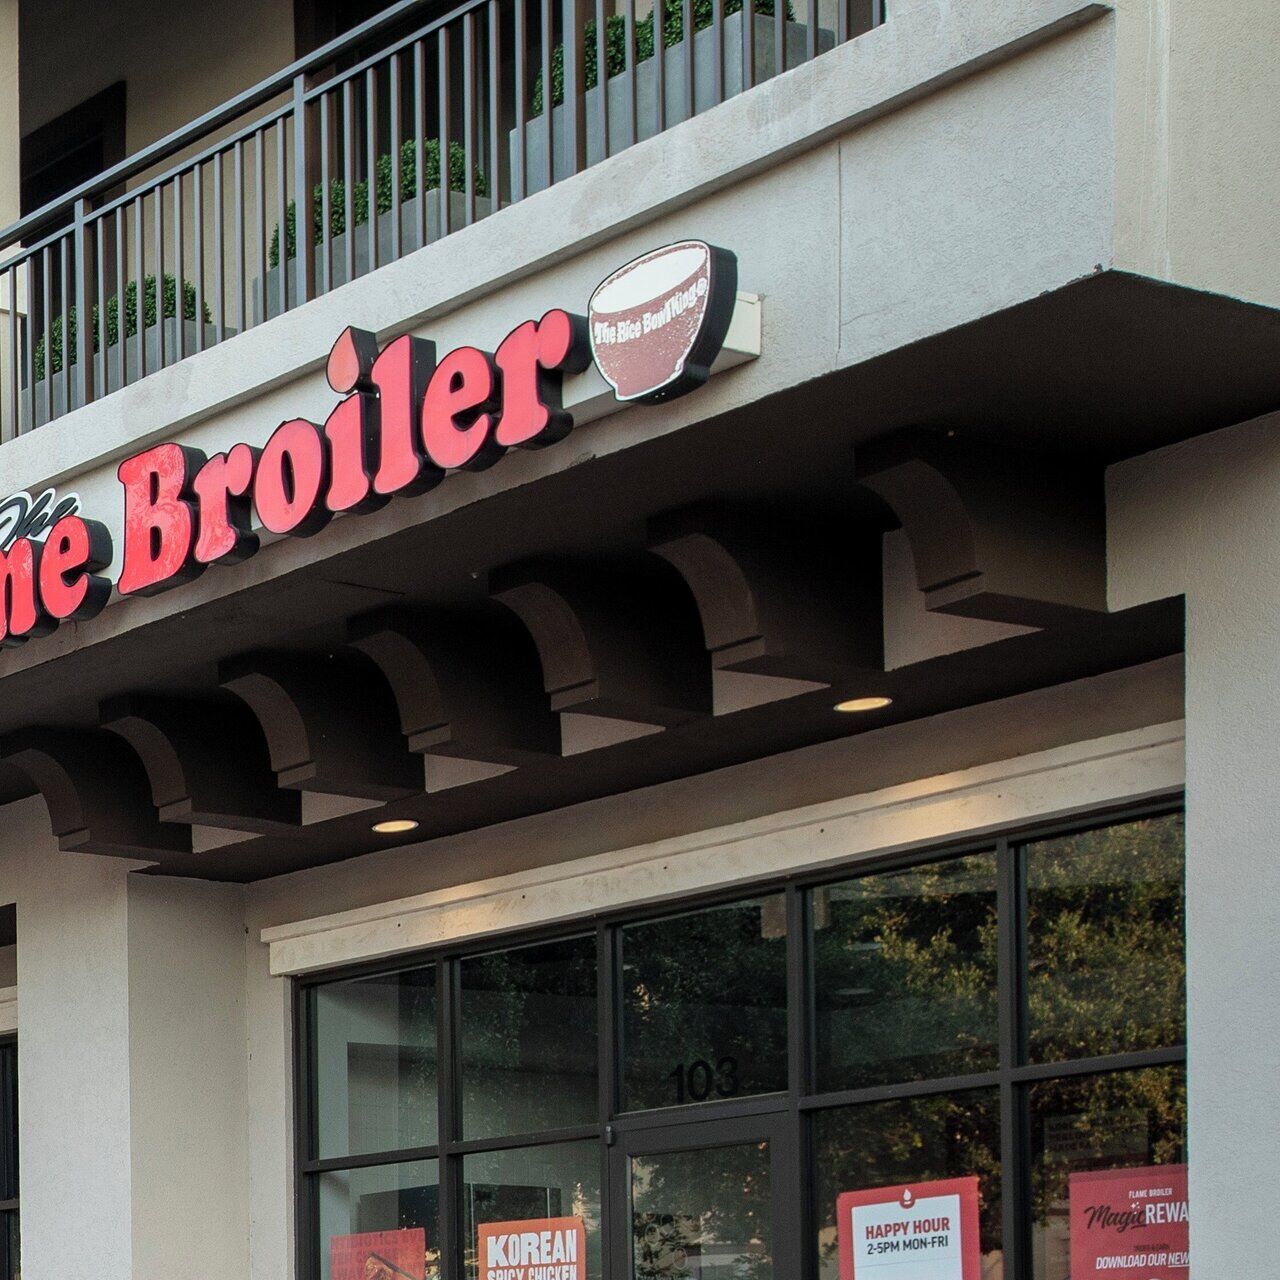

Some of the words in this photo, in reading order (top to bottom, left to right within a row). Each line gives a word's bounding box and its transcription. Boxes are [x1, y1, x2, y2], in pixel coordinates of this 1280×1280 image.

[594, 322, 616, 345] The
[617, 321, 642, 344] Rice
[642, 303, 672, 334] Bowl
[117, 308, 582, 596] Broiler
[669, 1056, 738, 1104] 103
[1129, 1189, 1148, 1199] FLAME
[1149, 1187, 1173, 1198] BROILER
[865, 1221, 910, 1240] HAPPY
[913, 1217, 950, 1234] HOUR
[1084, 1204, 1147, 1233] Magic
[487, 1230, 577, 1268] KOREAN
[867, 1241, 900, 1255] 2-5PM
[902, 1235, 949, 1251] MON-FRI
[1096, 1254, 1145, 1269] DOWNLOAD
[1147, 1253, 1166, 1266] OUR
[1168, 1251, 1190, 1267] NEW
